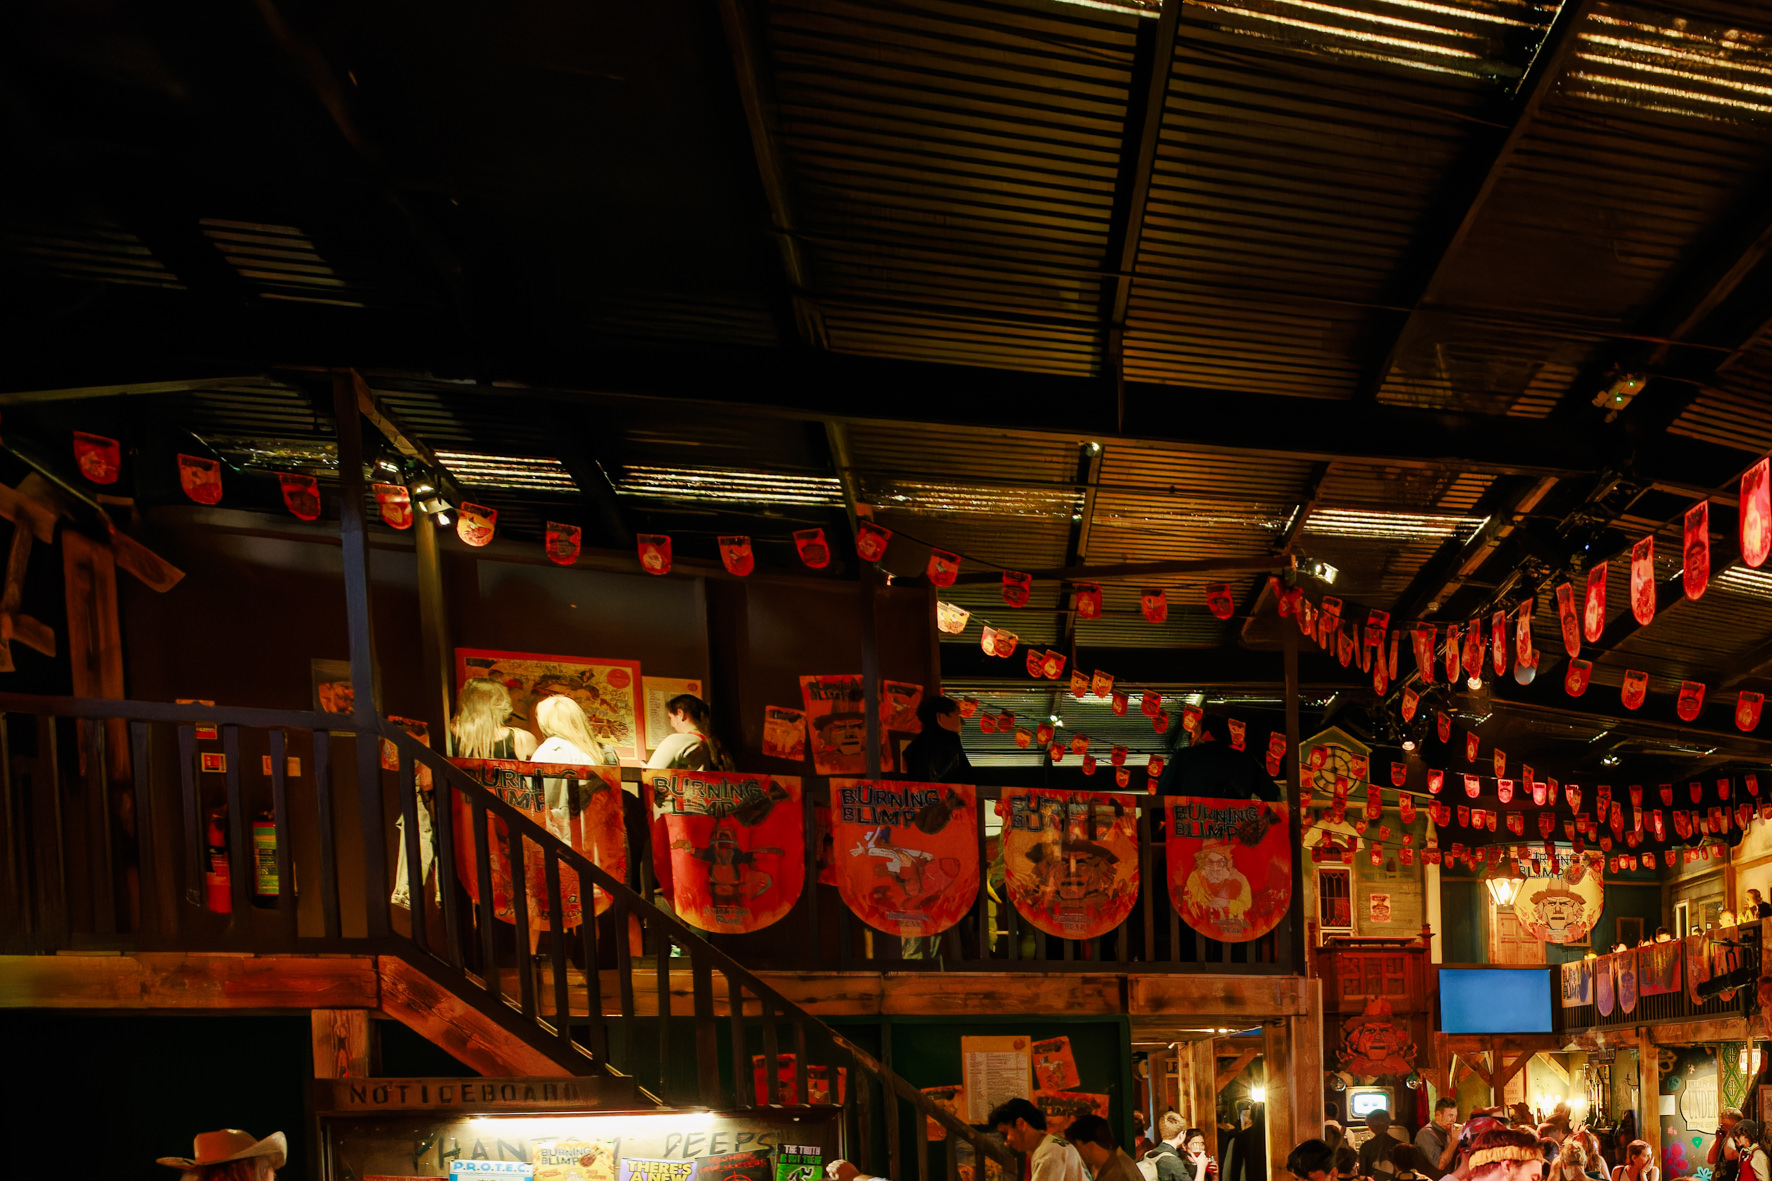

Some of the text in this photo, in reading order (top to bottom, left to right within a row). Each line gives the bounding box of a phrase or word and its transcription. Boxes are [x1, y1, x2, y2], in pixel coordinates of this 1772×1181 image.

[652, 776, 765, 801] BURNING
[840, 785, 942, 808] BURNING
[841, 804, 916, 828] BLIMP
[1173, 801, 1259, 824] BURNING
[1174, 819, 1240, 842] BLIMP
[1519, 865, 1564, 880] BLMP
[350, 1083, 579, 1104] NOTICEBOARD
[541, 1147, 592, 1157] BURNING
[541, 1156, 580, 1166] BLIMP
[453, 1161, 530, 1173] P.R.O.T.E.C.
[628, 1161, 692, 1175] THERE'S
